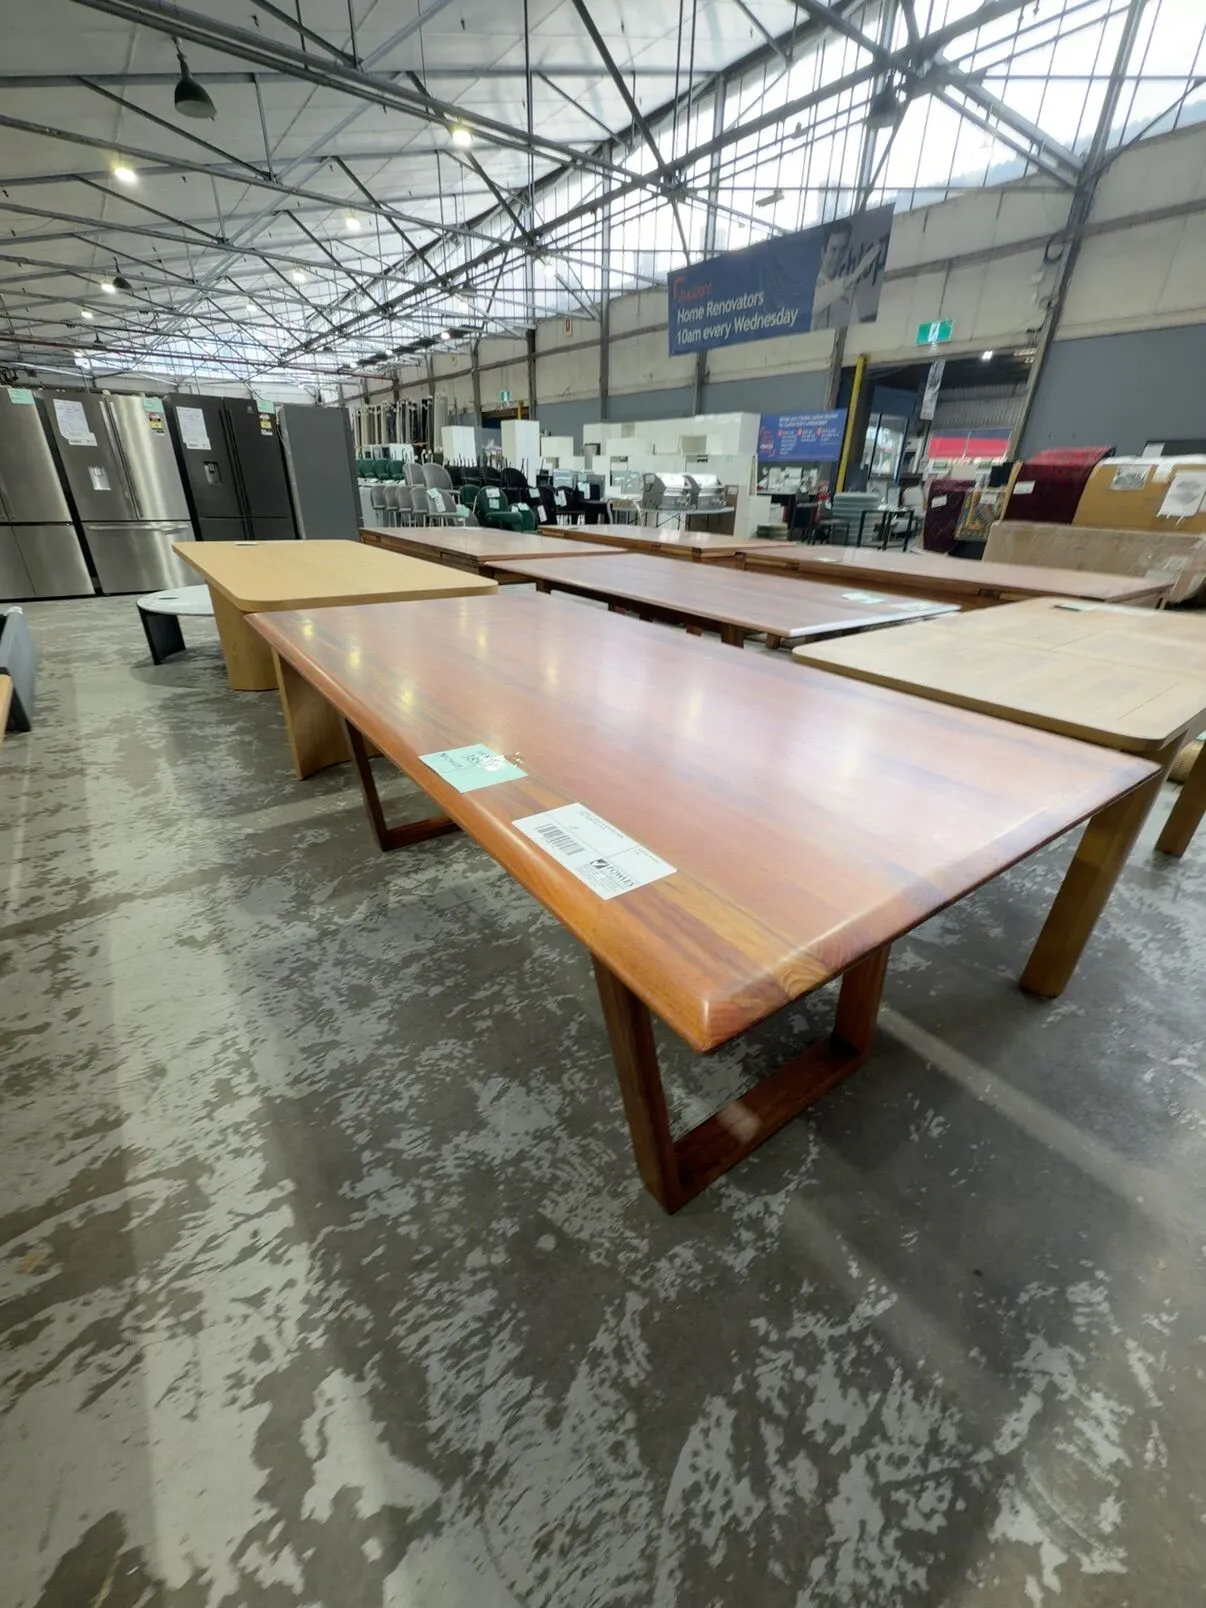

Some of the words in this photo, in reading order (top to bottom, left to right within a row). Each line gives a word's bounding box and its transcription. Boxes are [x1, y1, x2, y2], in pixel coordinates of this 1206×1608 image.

[676, 327, 701, 345] 10am
[702, 322, 732, 340] every
[733, 306, 800, 333] Wednesday
[677, 308, 705, 325] Home
[706, 290, 764, 317] Renovators
